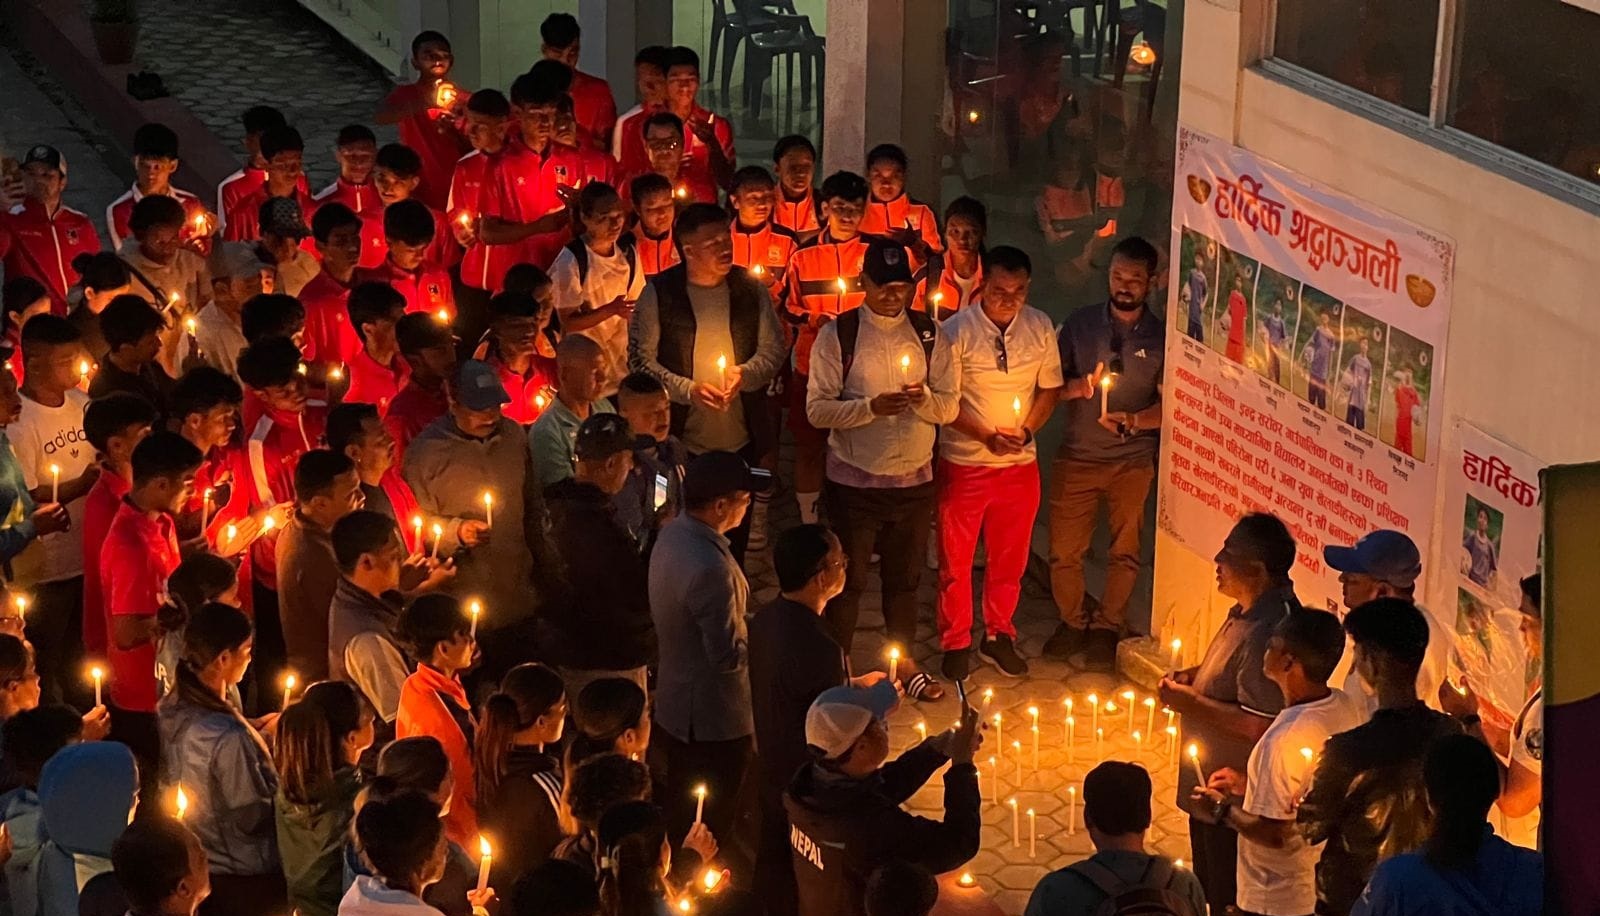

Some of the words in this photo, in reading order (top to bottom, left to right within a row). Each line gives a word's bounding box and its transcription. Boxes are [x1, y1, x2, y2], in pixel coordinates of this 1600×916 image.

[1214, 174, 1286, 236] हार्दिक
[1289, 209, 1402, 294] श्रद्धाञ्जली
[44, 426, 87, 454] adida
[1256, 458, 1269, 475] परी
[1298, 482, 1314, 500] युवा
[1274, 441, 1306, 472] विद्यालय
[1377, 502, 1409, 531] प्रशिक्षण
[1329, 453, 1344, 470] वडा
[1366, 469, 1388, 495] स्थित
[1463, 450, 1537, 507] हार्दिक
[791, 824, 824, 870] NEPAL
